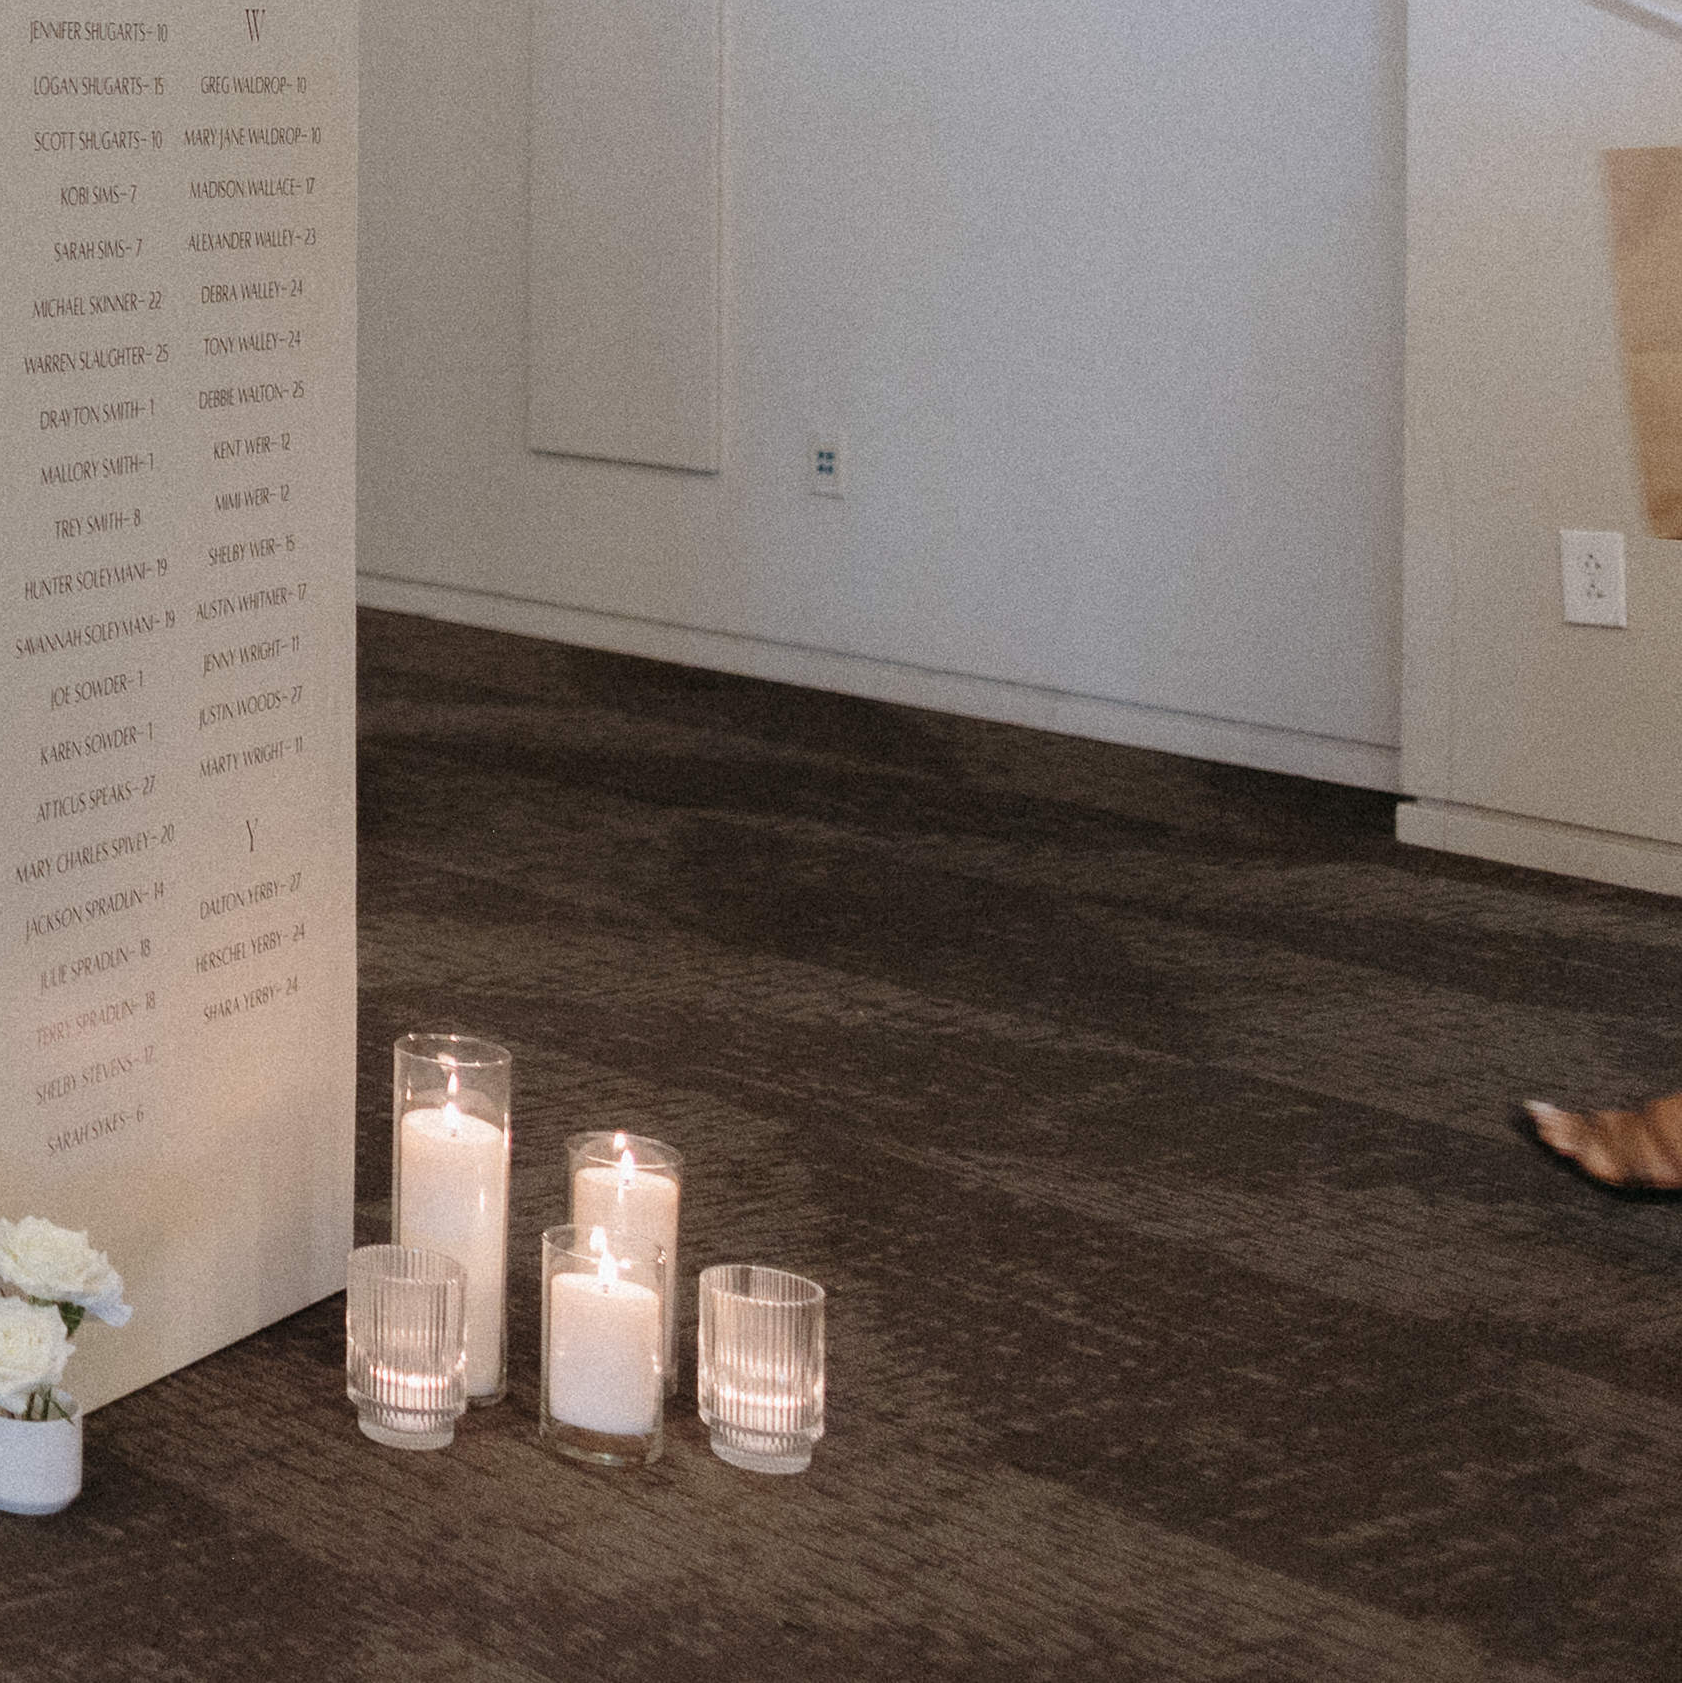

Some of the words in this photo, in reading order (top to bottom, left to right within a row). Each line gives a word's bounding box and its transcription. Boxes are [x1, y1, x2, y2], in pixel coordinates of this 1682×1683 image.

[245, 8, 265, 41] W
[202, 284, 237, 304] DEBRA
[291, 279, 302, 297] 24
[55, 518, 81, 538] TREY
[134, 508, 141, 527] 8
[246, 818, 257, 853] Y
